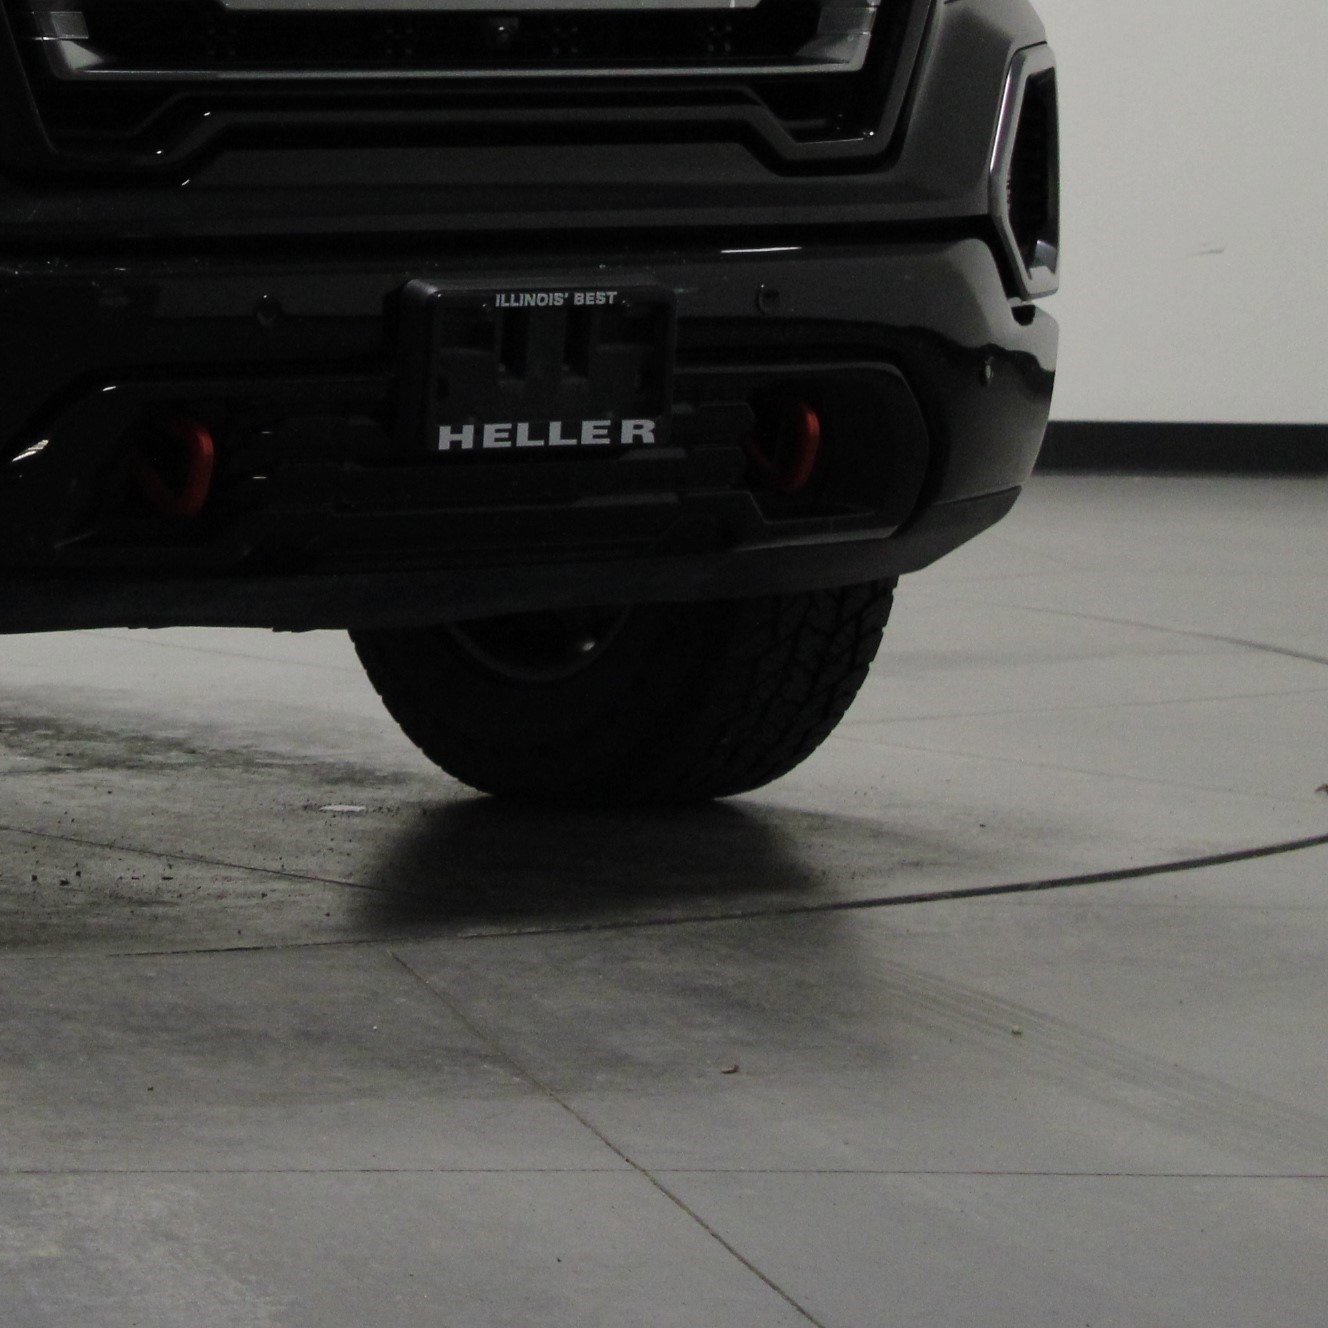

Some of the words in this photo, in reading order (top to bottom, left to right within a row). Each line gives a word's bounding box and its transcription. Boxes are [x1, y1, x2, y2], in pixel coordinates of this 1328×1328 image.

[495, 292, 568, 307] ILLINOIS'
[574, 291, 618, 305] BEST
[438, 419, 656, 450] HELLER
